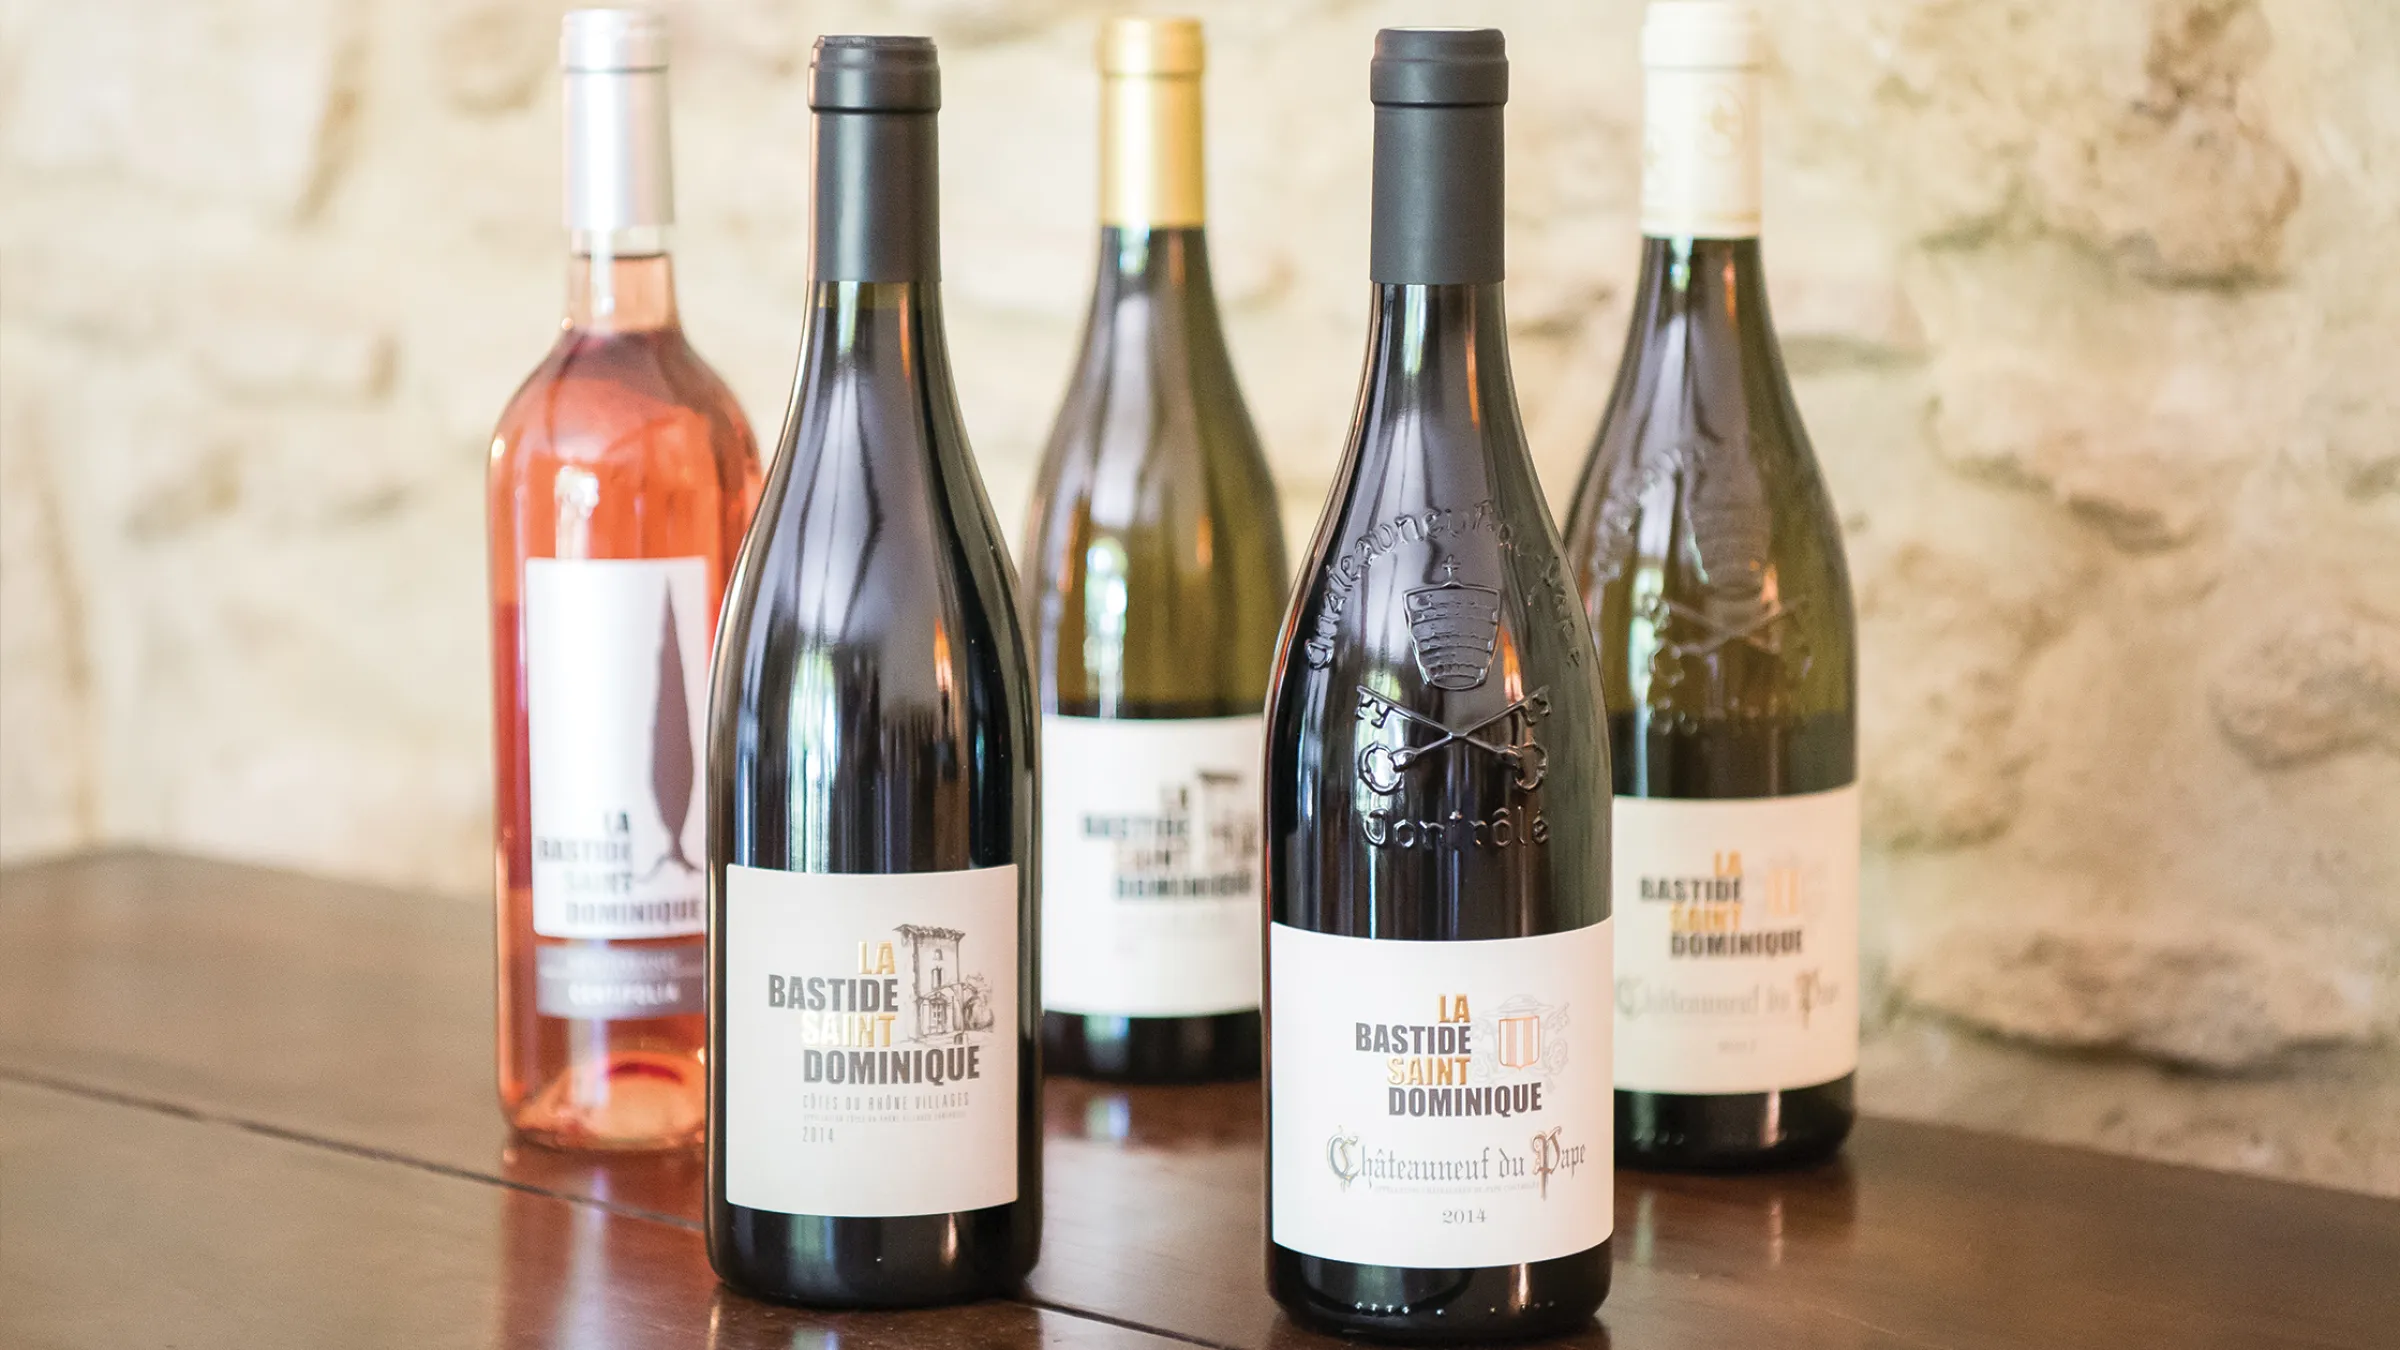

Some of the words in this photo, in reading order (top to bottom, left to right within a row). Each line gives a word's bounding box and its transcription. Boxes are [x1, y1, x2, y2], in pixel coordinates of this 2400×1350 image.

[603, 811, 630, 835] LA
[1714, 851, 1743, 877] LA
[1640, 876, 1742, 903] BASTIDE
[566, 899, 701, 925] DOMINIQUE
[1670, 928, 1803, 957] DOMINIQUE
[858, 941, 896, 975] LA
[768, 974, 899, 1013] BASTIDE
[1438, 993, 1472, 1024] LA
[801, 1011, 896, 1048] SAINT
[1355, 1022, 1472, 1055] BASTIDE
[803, 1045, 980, 1086] DOMINIQUE
[1387, 1056, 1471, 1086] SAINT
[803, 1093, 838, 1111] CÔTES
[846, 1096, 860, 1111] DU
[868, 1094, 908, 1111] RHÔNE
[915, 1091, 969, 1110] VILLAGES
[1388, 1082, 1542, 1118] DOMINIQUE
[803, 1126, 835, 1144] 2014
[1327, 1125, 1488, 1193] Châteauneuf
[1499, 1147, 1525, 1179] du
[1531, 1126, 1586, 1200] Pape
[1442, 1208, 1487, 1224] 2014
